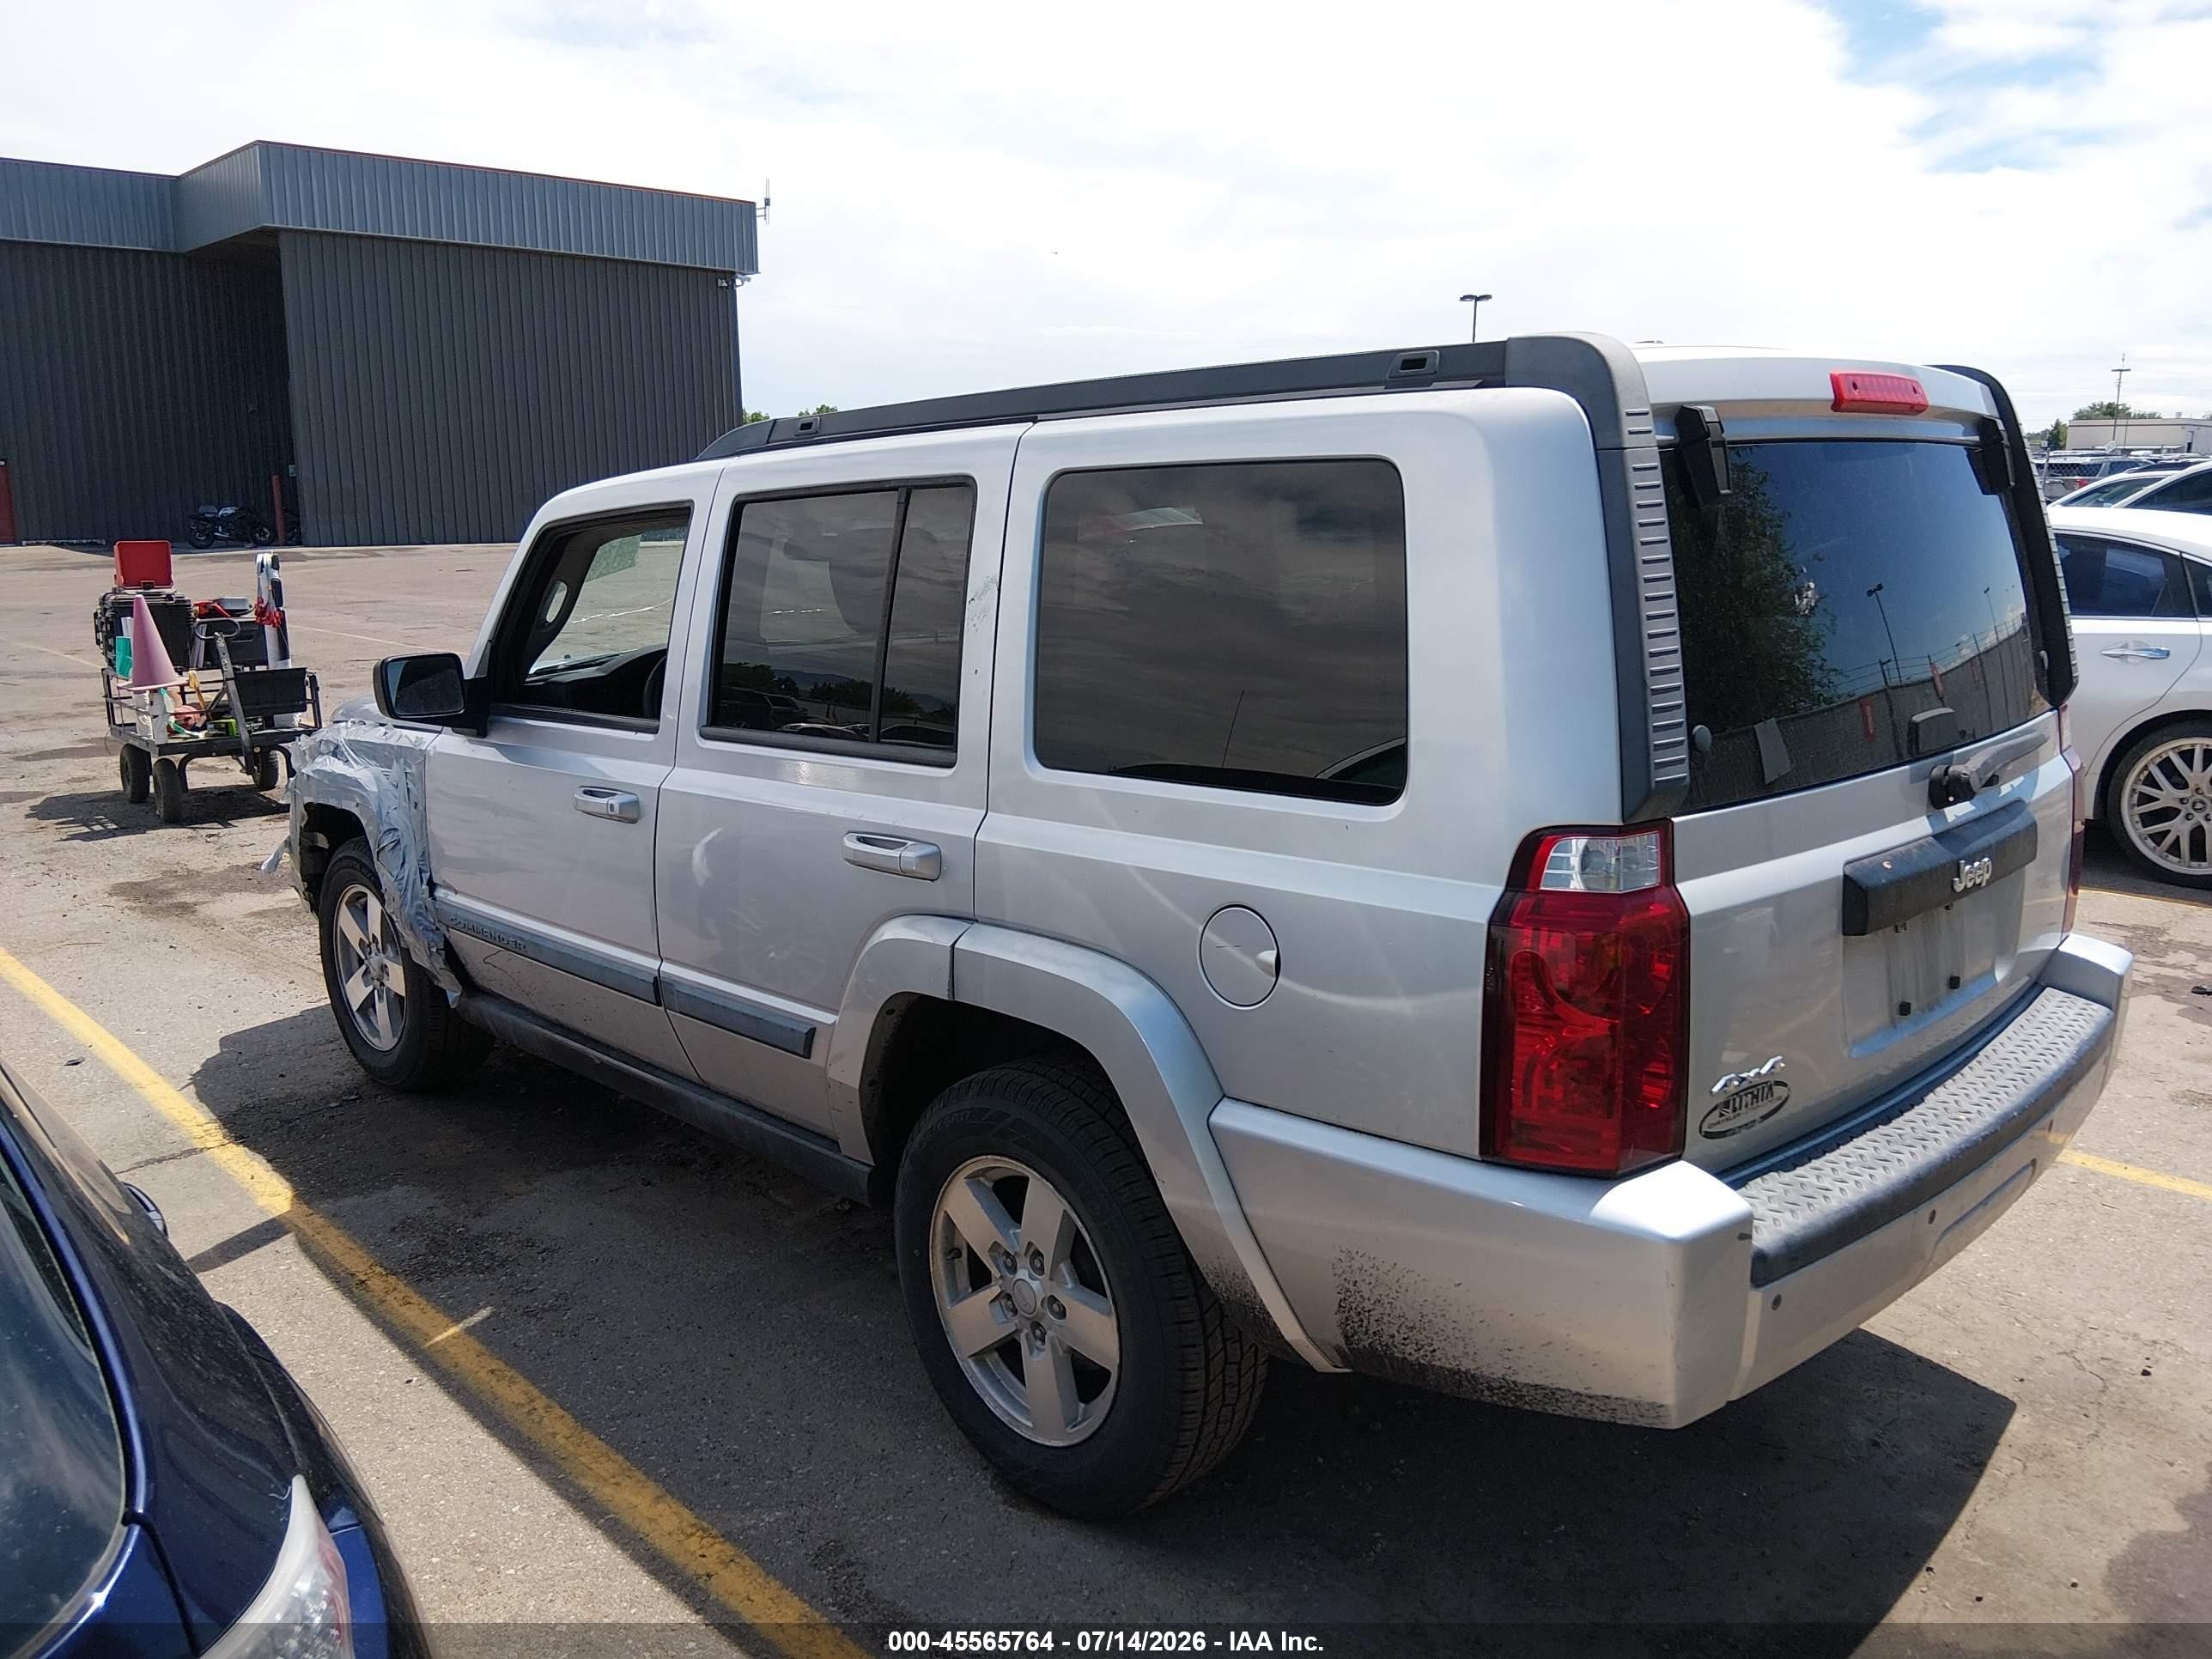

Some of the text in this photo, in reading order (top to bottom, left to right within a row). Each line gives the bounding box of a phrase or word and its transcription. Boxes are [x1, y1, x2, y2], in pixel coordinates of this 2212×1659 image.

[1951, 857, 1993, 893] Jeep
[450, 916, 527, 951] COMMANDER
[1731, 1083, 1774, 1113] LITHIA
